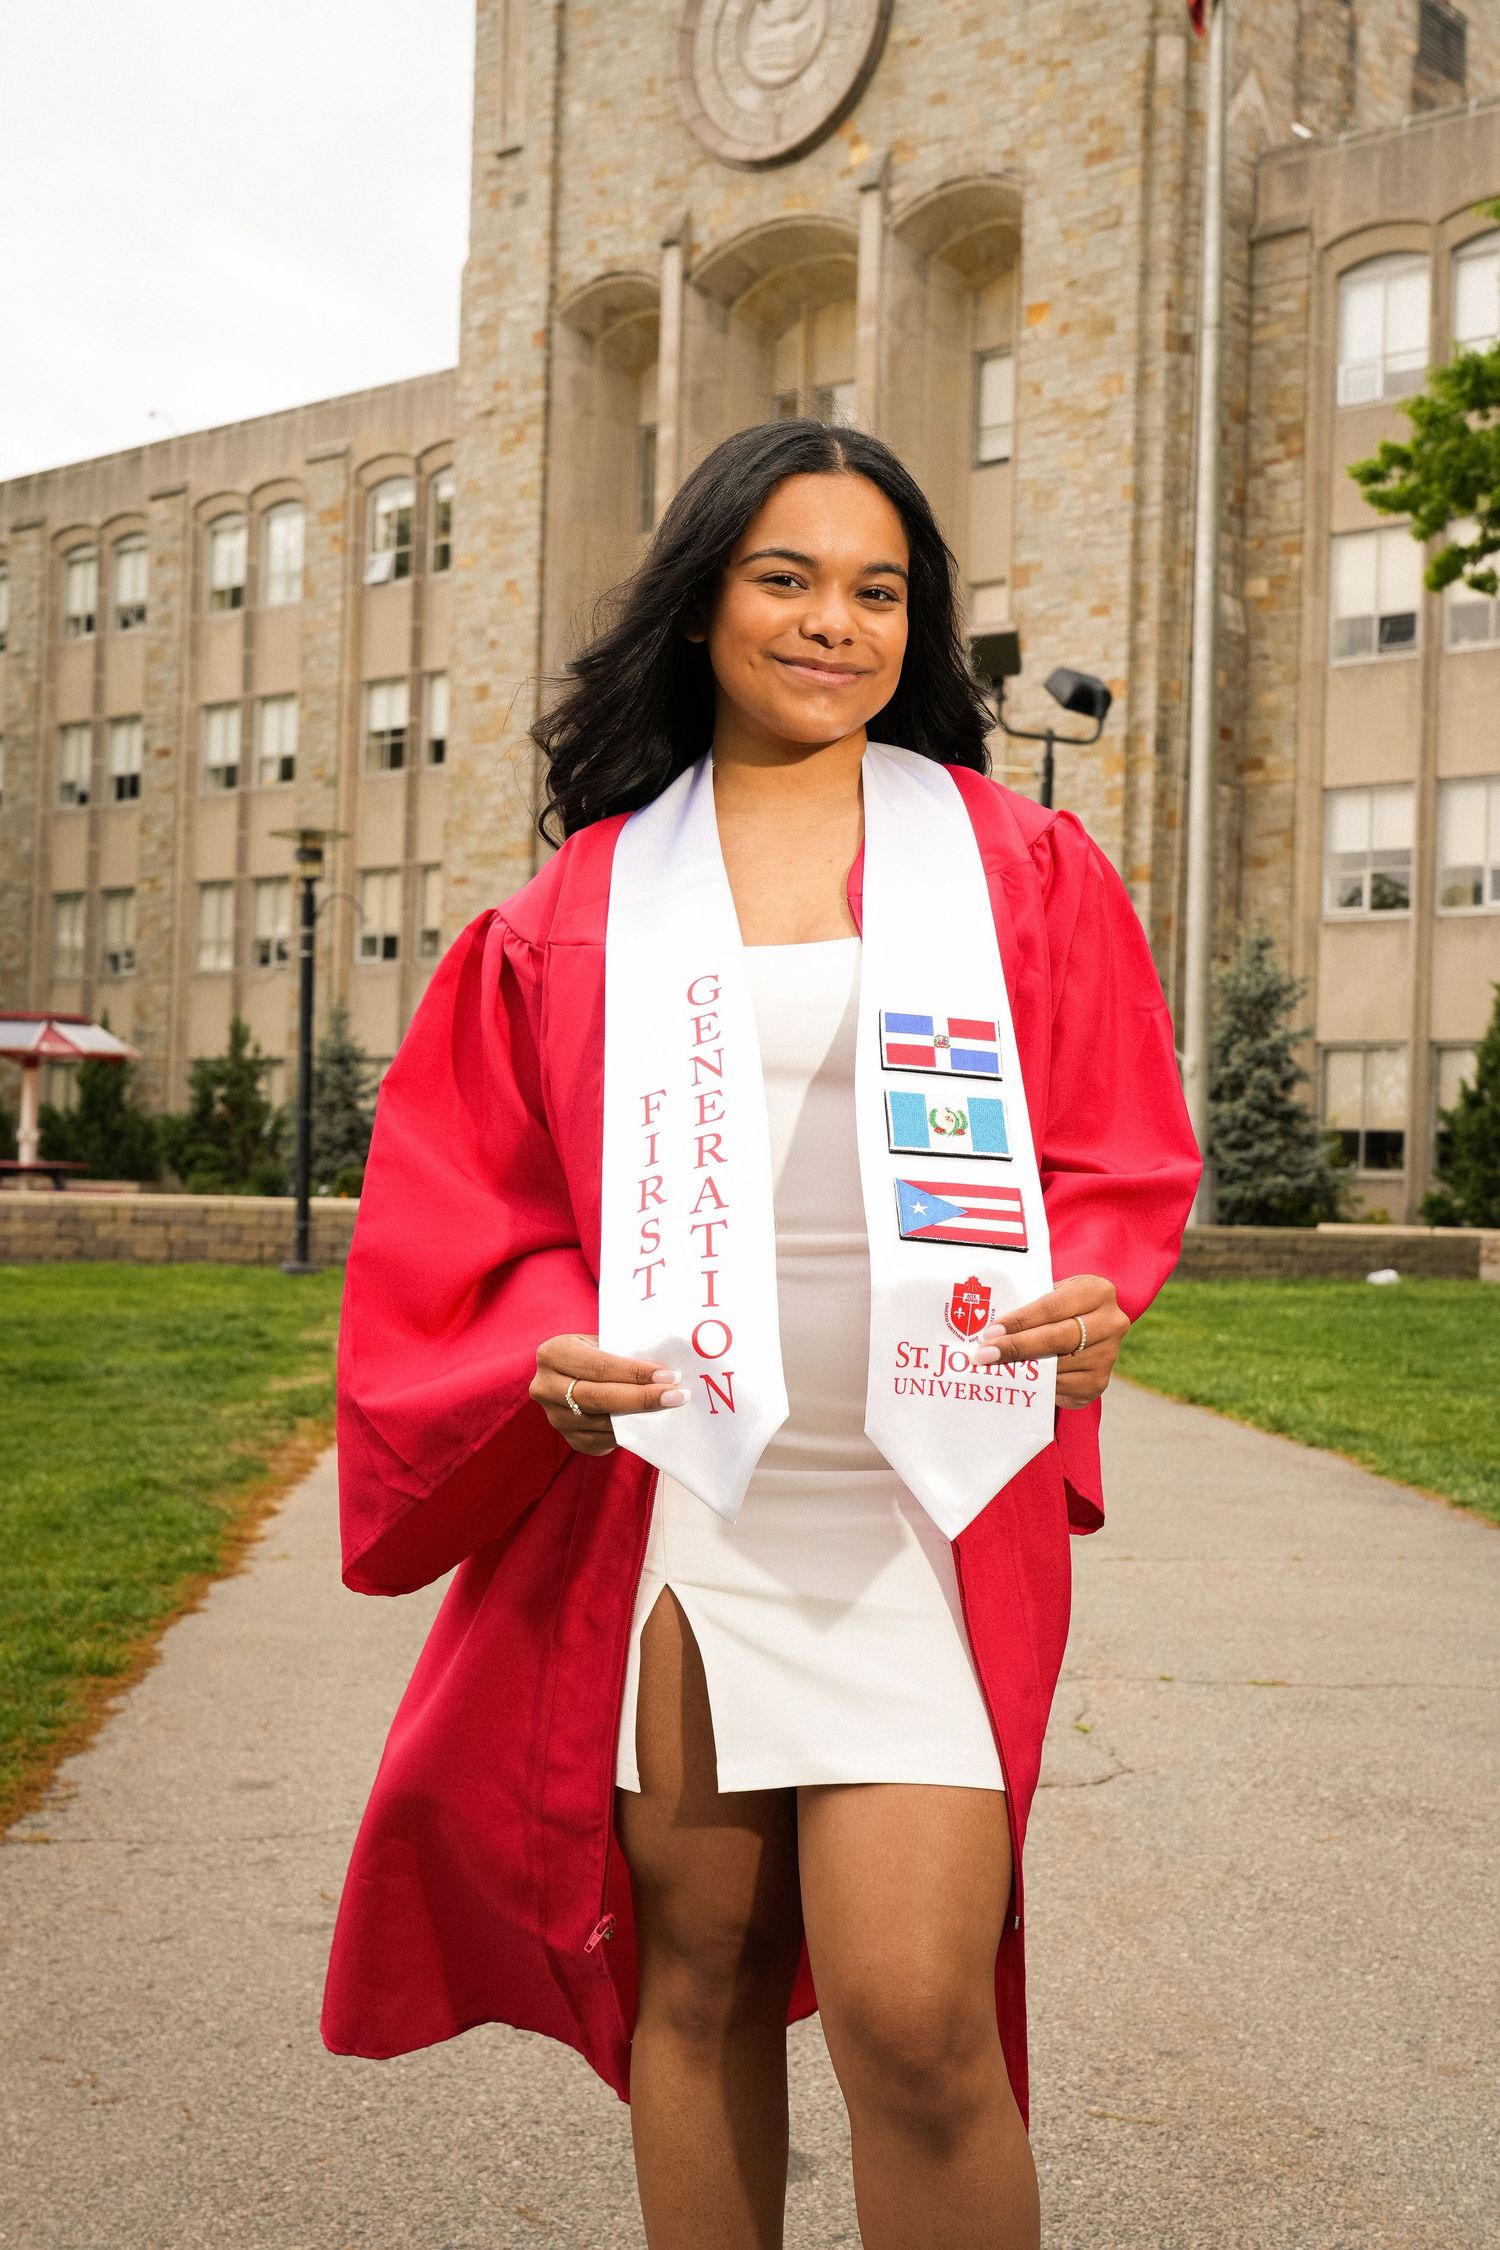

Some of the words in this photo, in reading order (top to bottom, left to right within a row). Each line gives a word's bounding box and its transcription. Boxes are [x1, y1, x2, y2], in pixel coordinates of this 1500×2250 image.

[633, 1088, 667, 1301] FIRST
[687, 974, 736, 1415] GENERATION
[894, 1377, 1038, 1408] UNIVERSITY
[895, 1341, 929, 1370] ST.
